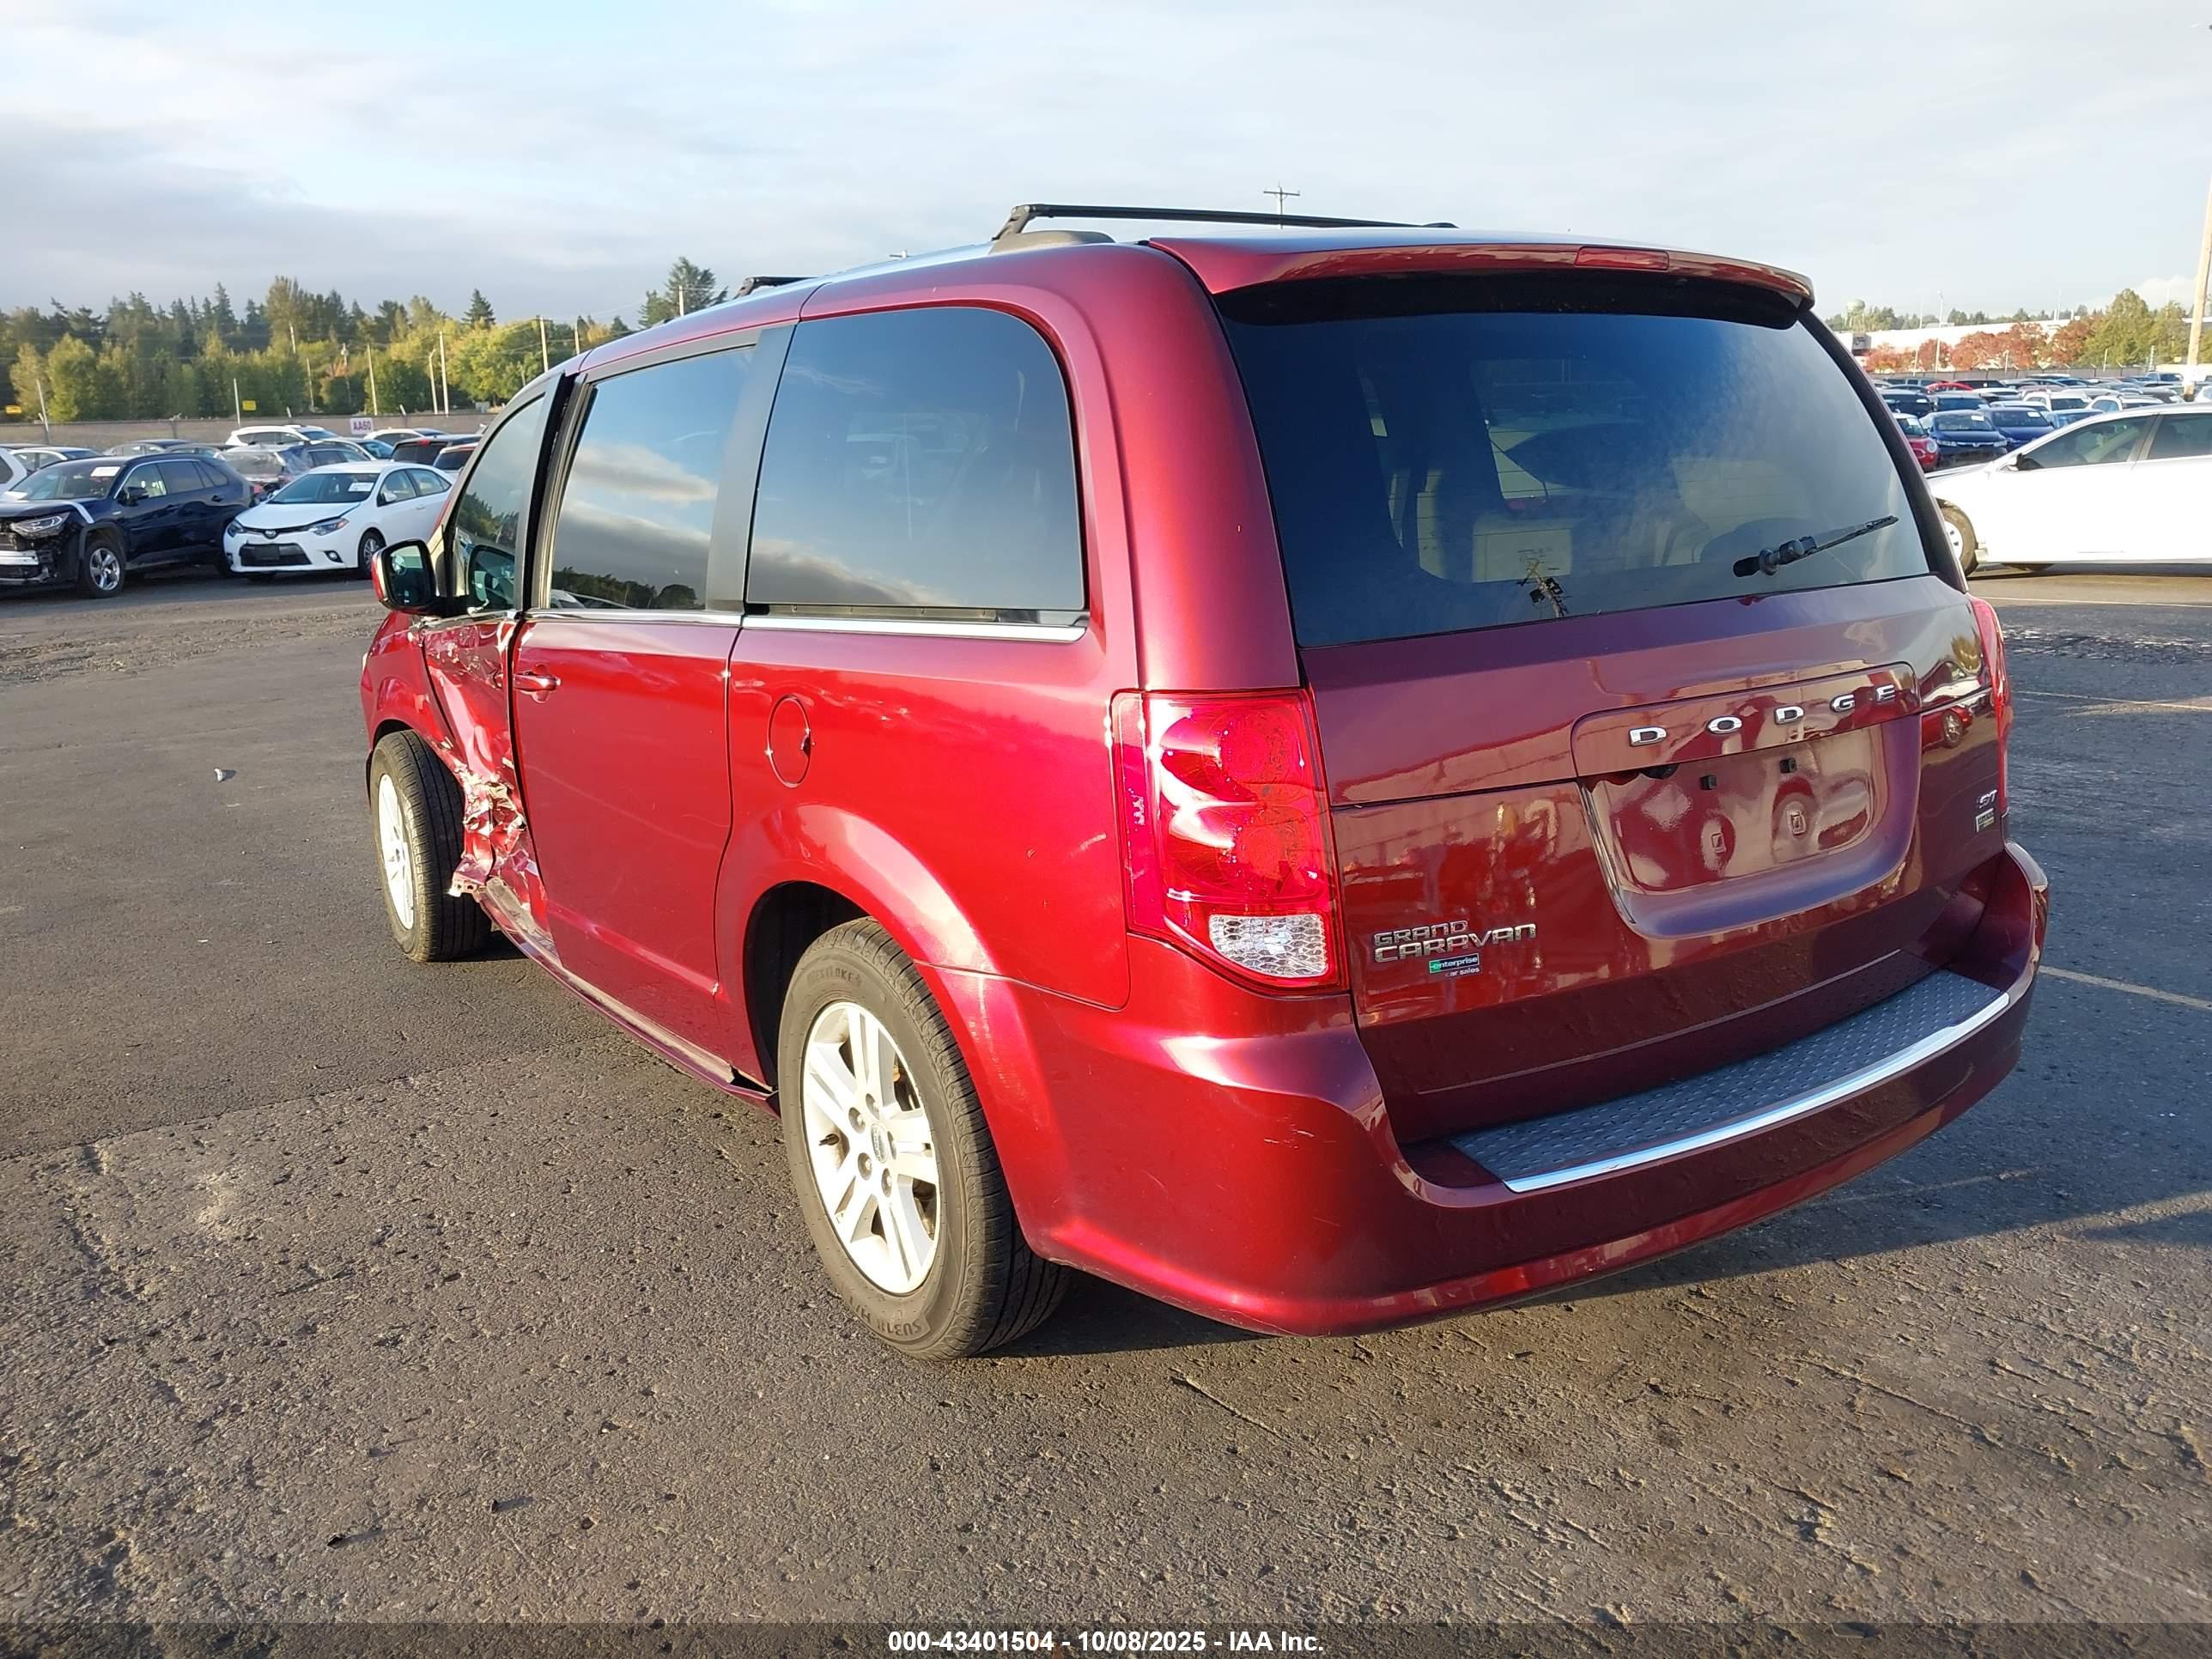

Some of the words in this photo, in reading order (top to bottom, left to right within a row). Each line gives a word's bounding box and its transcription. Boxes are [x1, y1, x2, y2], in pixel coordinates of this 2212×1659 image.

[1628, 684, 1895, 746] DODGE
[1374, 920, 1468, 945] GRAND
[1375, 923, 1536, 963] CARAVAN
[1431, 957, 1478, 969] enterprise
[1459, 967, 1480, 975] sales
